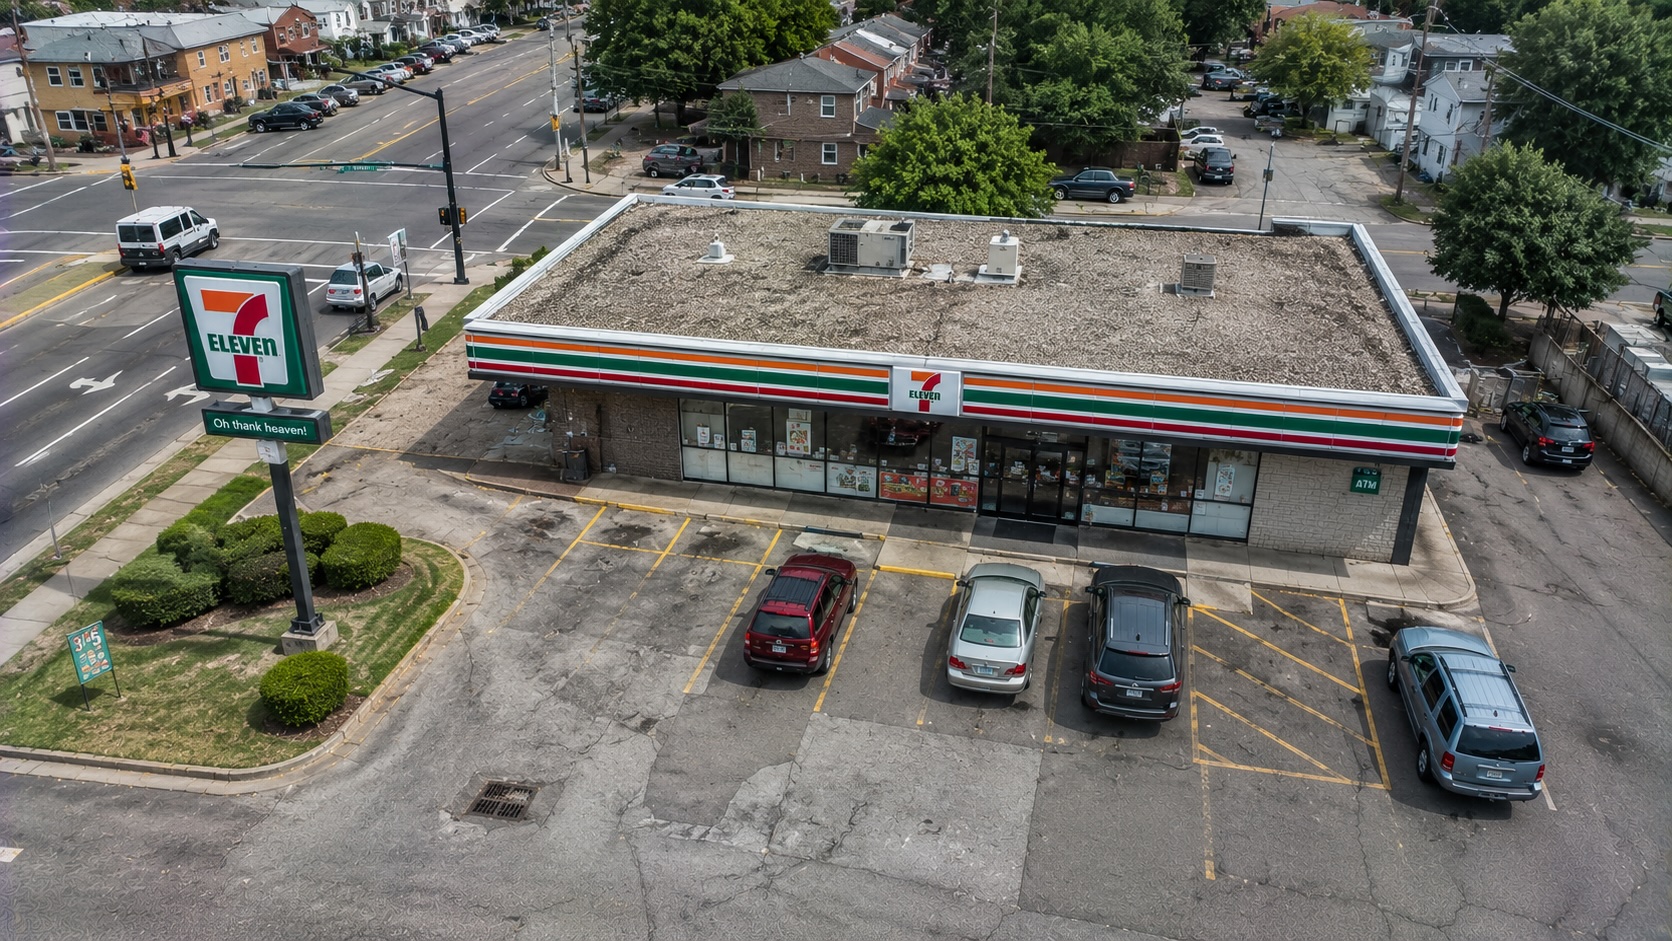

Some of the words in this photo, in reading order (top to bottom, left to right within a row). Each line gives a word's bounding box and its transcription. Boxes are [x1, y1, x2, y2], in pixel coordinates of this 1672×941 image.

[201, 289, 268, 386] 7
[213, 418, 230, 429] Oh
[232, 420, 262, 432] thank
[264, 423, 307, 435] heaven!
[1355, 479, 1377, 490] ATM
